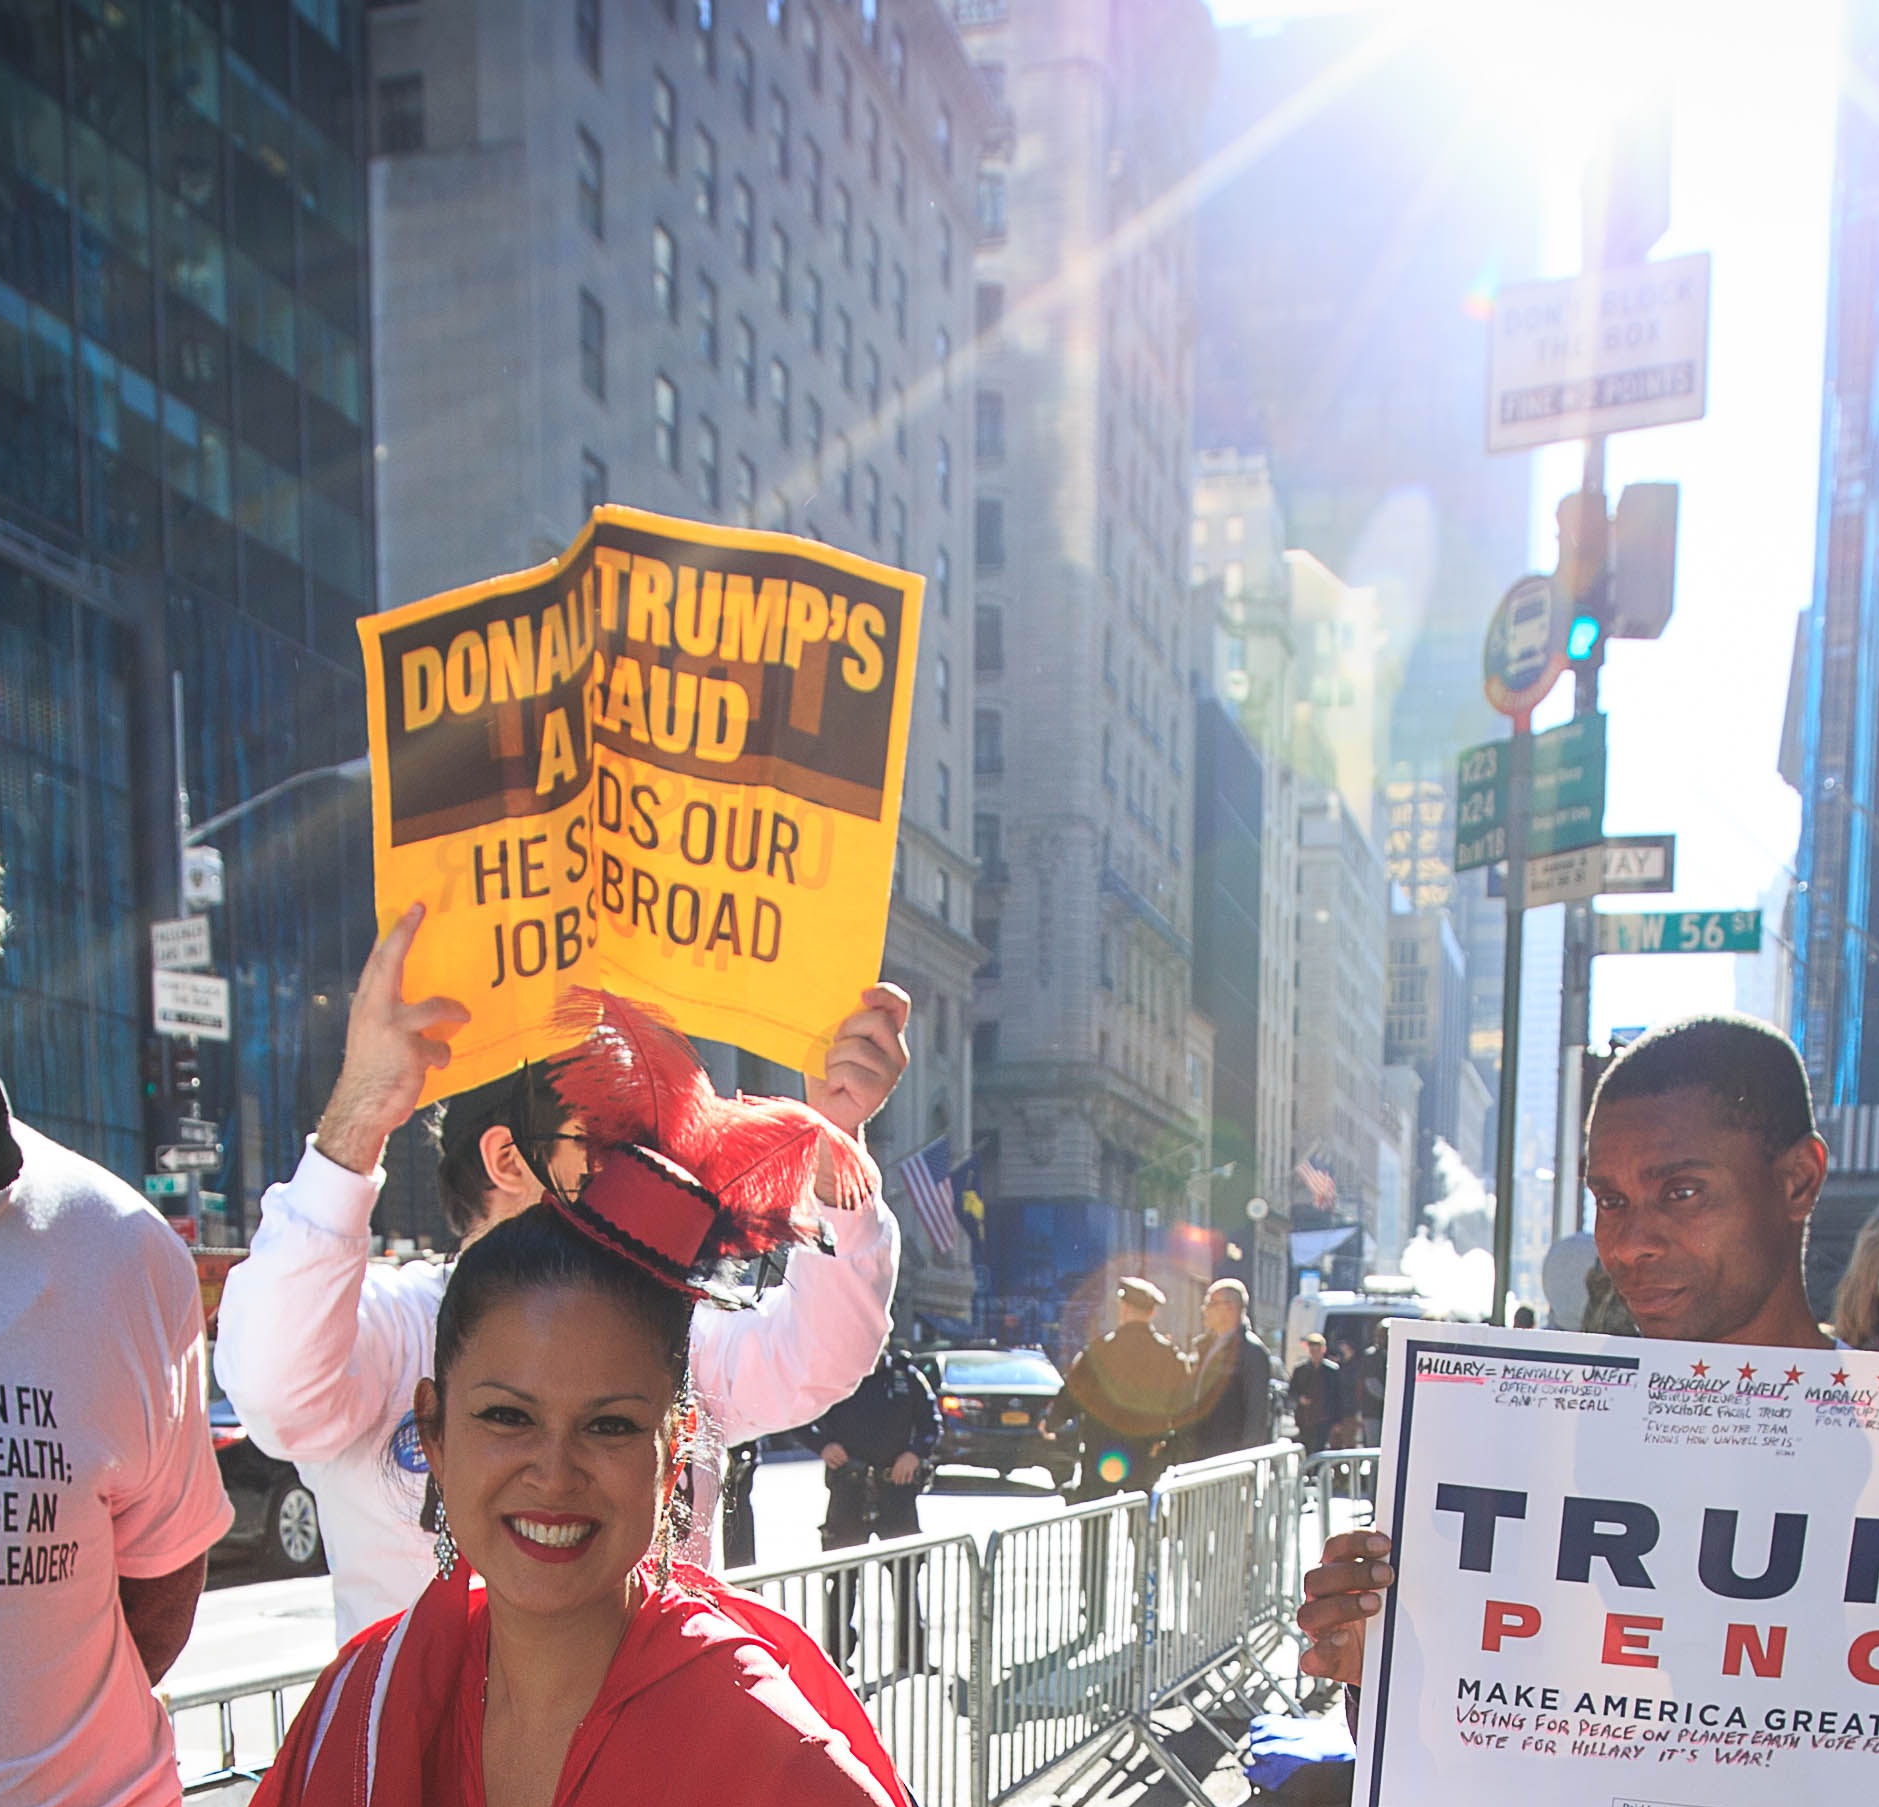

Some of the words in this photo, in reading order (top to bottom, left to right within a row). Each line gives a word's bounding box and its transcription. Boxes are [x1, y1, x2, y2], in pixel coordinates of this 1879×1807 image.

[595, 546, 887, 693] TRUMP'S
[536, 708, 577, 796] A
[473, 835, 549, 906] HE
[680, 801, 801, 886] OUR
[1641, 916, 1665, 951] W
[1680, 914, 1725, 950] 56
[1733, 910, 1758, 932] ST
[1501, 1365, 1573, 1380] MENTALLY
[17, 1386, 57, 1429] FIX
[1554, 1397, 1610, 1411] RECALL
[1805, 1386, 1878, 1405] MORALLY
[1686, 1434, 1708, 1445] HOW
[1714, 1435, 1758, 1446] UNWELL
[1712, 1423, 1729, 1434] ON
[1758, 1423, 1788, 1434] TEAM
[1815, 1416, 1842, 1427] FOR
[26, 1494, 57, 1532] AN
[1457, 1678, 1560, 1711] MAKE
[1574, 1692, 1748, 1729] AMERICA
[1456, 1704, 1527, 1731] VOTING
[1535, 1713, 1570, 1734] FOR
[1579, 1719, 1638, 1742] PEACE
[1642, 1729, 1671, 1743] ON
[1677, 1729, 1749, 1746] PLANET
[1751, 1730, 1801, 1749] EARTH
[1810, 1732, 1860, 1751] VOTE
[1460, 1731, 1509, 1749] VOTE
[1522, 1736, 1557, 1755] FOR
[1571, 1740, 1645, 1761] HILLARY
[1715, 1748, 1774, 1768] WAR!
